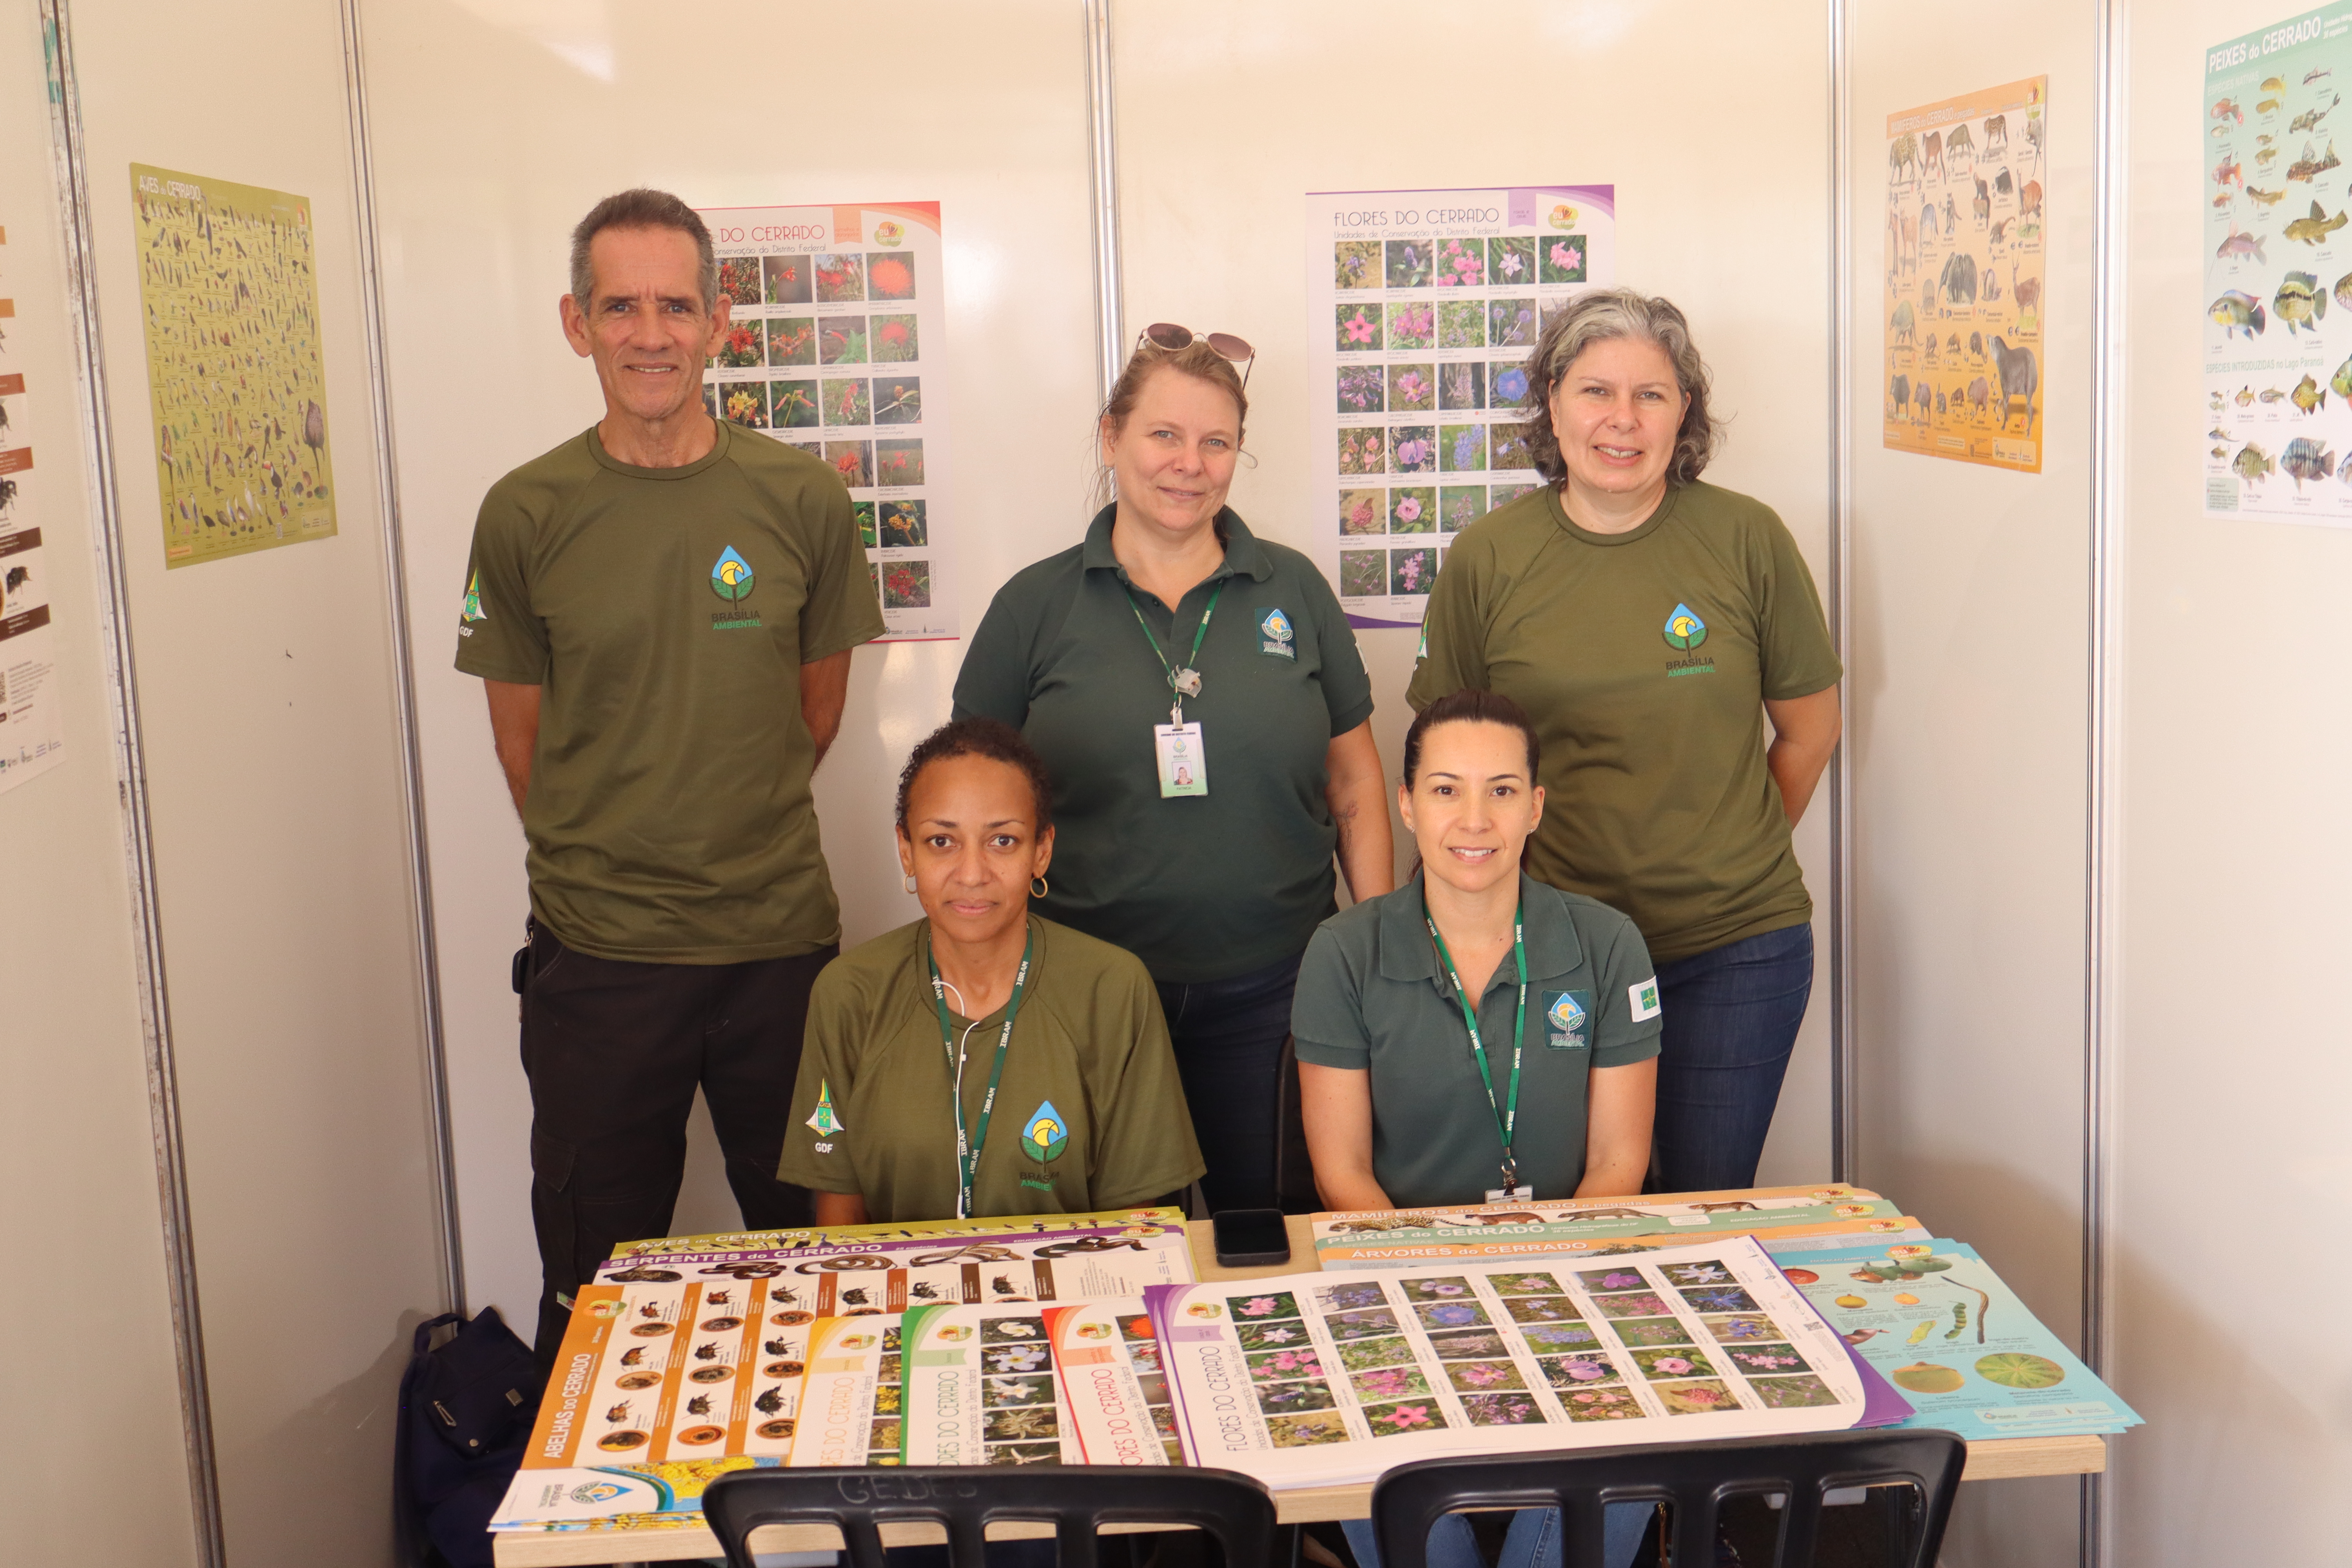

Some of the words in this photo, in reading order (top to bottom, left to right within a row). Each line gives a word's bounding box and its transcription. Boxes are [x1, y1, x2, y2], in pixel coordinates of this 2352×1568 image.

[2209, 42, 2246, 74] PEIXES
[2249, 44, 2259, 60] do
[2262, 16, 2321, 55] CERRADO
[2234, 71, 2259, 86] NATIVAS
[1921, 117, 1927, 127] do
[1927, 107, 1953, 125] CERRADO
[139, 175, 159, 194] AVES
[167, 181, 200, 201] CERRADO
[1334, 211, 1388, 227] FLORES
[1396, 210, 1419, 225] DO
[1432, 208, 1499, 224] CERRADO
[720, 227, 745, 243] DO
[752, 225, 825, 242] CERRADO
[1334, 230, 1365, 239] Unidades
[1369, 229, 1378, 238] de
[1382, 229, 1430, 238] Conservação
[1447, 227, 1469, 236] Distrito
[1473, 227, 1500, 235] Federal
[713, 247, 755, 256] onservação
[759, 245, 769, 254] do
[773, 245, 795, 253] Distrito
[799, 243, 826, 252] Federal
[2232, 359, 2274, 372] INTRODUZIDAS
[2285, 358, 2298, 370] Lago
[2300, 356, 2324, 367] Paranoá
[711, 609, 760, 622] BRASÍLIA
[713, 619, 762, 630] AMBIENTAL
[459, 626, 474, 638] GDF
[1666, 655, 1714, 670] BRASÍLIA
[1668, 665, 1716, 678] AMBIENTAL
[1016, 961, 1029, 987] IBRAM
[1000, 1021, 1012, 1048] IBRAM
[945, 1041, 954, 1067] IBRAM
[983, 1087, 996, 1114] IBRAM
[815, 1142, 833, 1154] GDF
[969, 1149, 980, 1175] IBRAM
[1332, 1209, 1448, 1220] MAMÍFEROS
[1479, 1203, 1577, 1212] CERRADO
[637, 1238, 690, 1249] AVES
[715, 1231, 811, 1242] CERRADO
[1327, 1231, 1405, 1244] PEIXES
[1437, 1226, 1545, 1236] CERRADO
[610, 1253, 740, 1267] SERPENTES
[774, 1244, 882, 1258] CERRADO
[1351, 1247, 1452, 1258] ÁRVORES
[1484, 1242, 1588, 1254] CERRADO
[1225, 1345, 1240, 1363] Federal
[561, 1353, 591, 1398] CERRADO
[1199, 1346, 1230, 1391] CERRADO
[1234, 1363, 1245, 1378] Distrito
[827, 1377, 855, 1425] CERRADO
[938, 1371, 959, 1417] CERRADO
[1091, 1369, 1125, 1415] CERRADO
[563, 1398, 578, 1410] DO
[1212, 1395, 1236, 1411] DO
[1242, 1388, 1258, 1419] Conservação
[937, 1421, 959, 1438] DO
[967, 1414, 981, 1445] Conservação
[1107, 1419, 1132, 1435] DO
[1137, 1410, 1154, 1442] Conservação
[1251, 1418, 1260, 1427] de
[544, 1410, 574, 1458] ABELHAS
[824, 1428, 847, 1445] DO
[850, 1421, 867, 1454] Conservação
[1218, 1415, 1249, 1452] FLORES
[1254, 1426, 1269, 1451] Unidades
